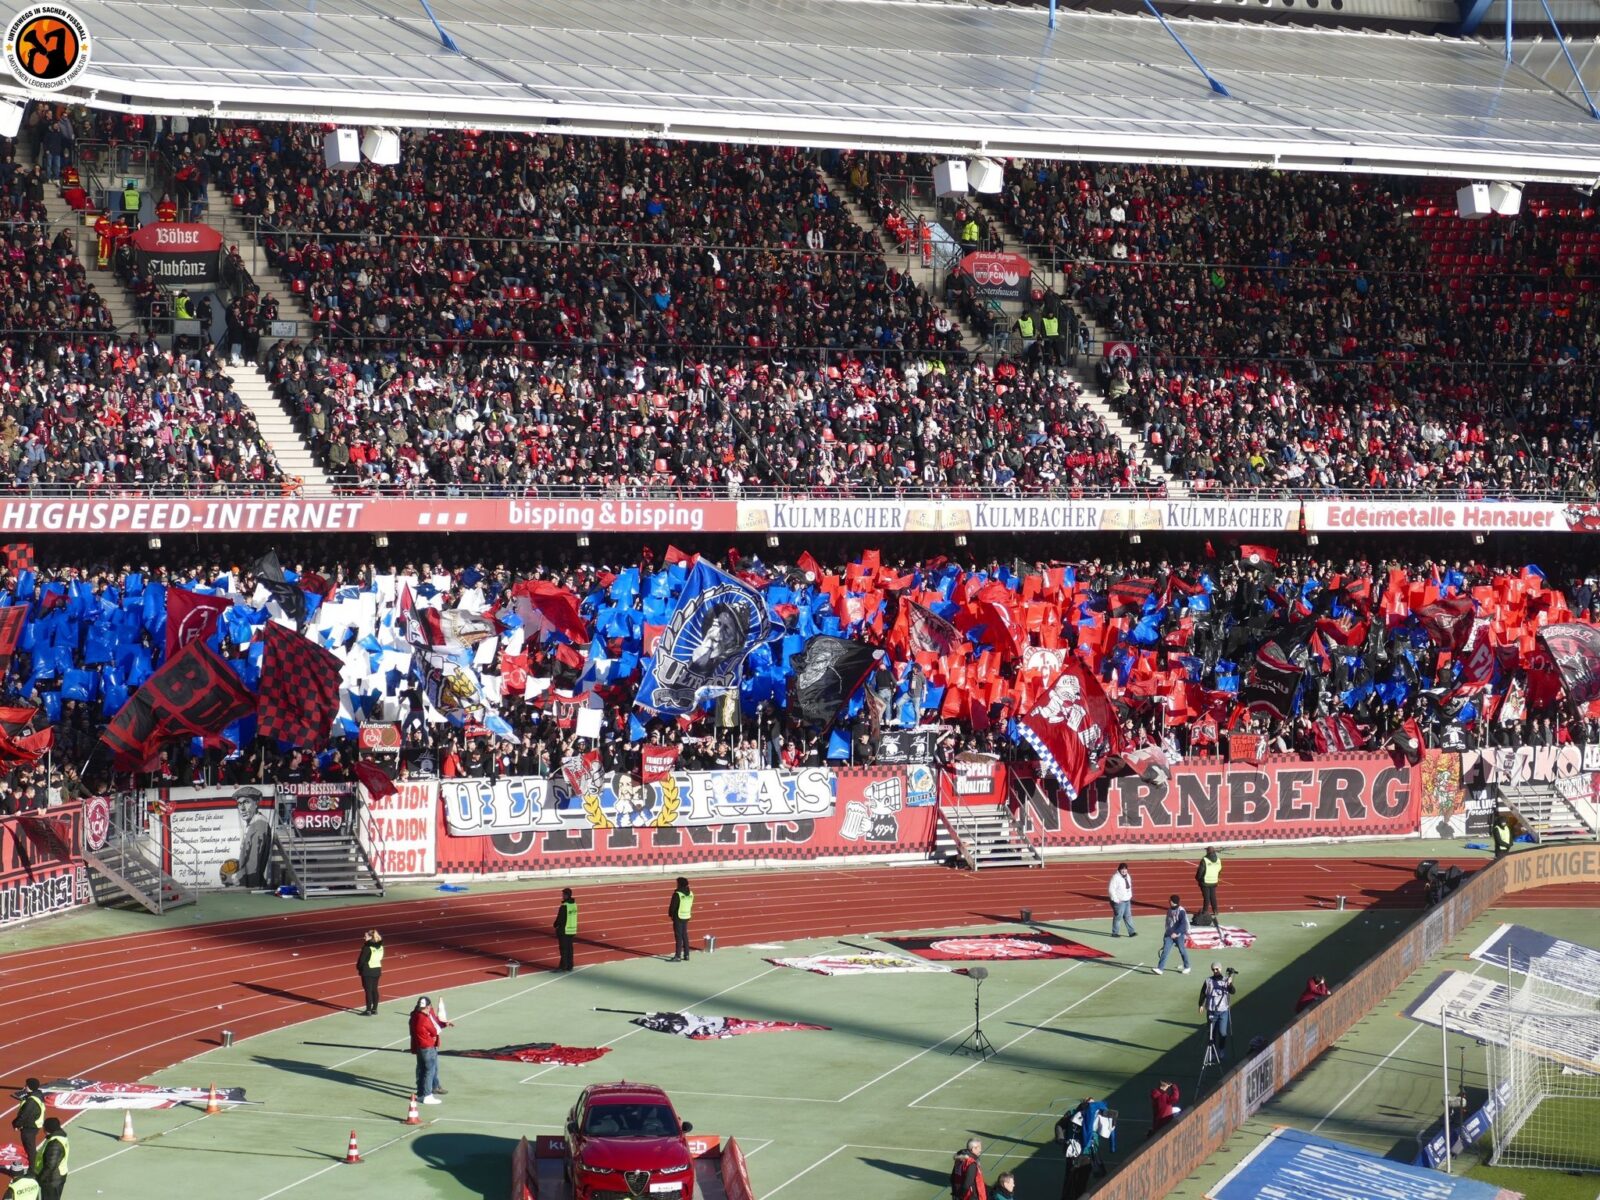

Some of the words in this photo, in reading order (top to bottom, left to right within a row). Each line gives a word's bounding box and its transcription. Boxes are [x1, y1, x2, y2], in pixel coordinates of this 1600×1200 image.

[156, 228, 199, 246] Böhse
[148, 259, 207, 277] Clubfanz
[2, 502, 363, 530] HIGHSPEED-INTERNET
[509, 501, 595, 530] bisping
[599, 502, 617, 525] &
[620, 502, 704, 530] bisping
[773, 503, 902, 528] KULMBACHER
[975, 503, 1097, 528] KULMBACHER
[1166, 502, 1283, 528] KULMBACHER
[1326, 505, 1455, 528] Edelmetalle
[1462, 506, 1554, 528] Hanauer
[371, 744, 400, 752] Nürnberg
[306, 815, 331, 828] RSR
[368, 817, 427, 842] STADION
[874, 823, 894, 837] 1994
[368, 848, 426, 873] VERBOT
[1514, 857, 1531, 884] INS
